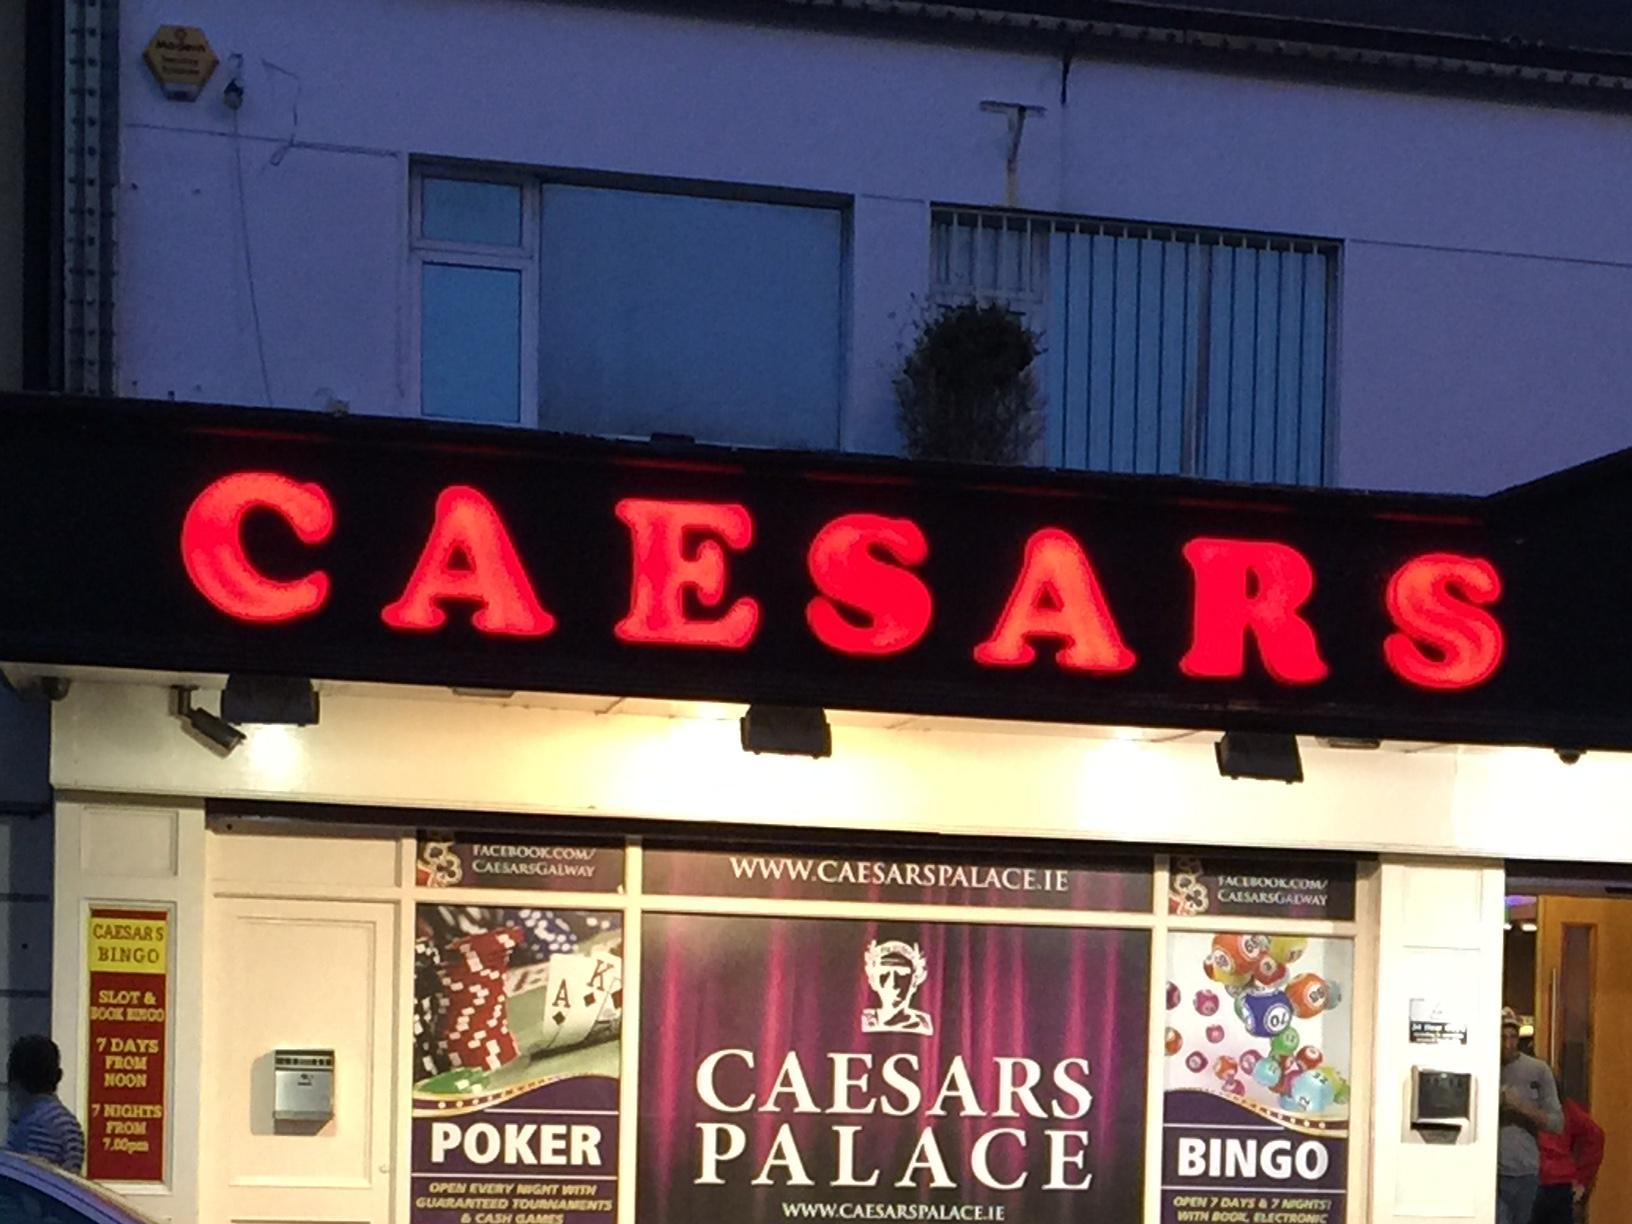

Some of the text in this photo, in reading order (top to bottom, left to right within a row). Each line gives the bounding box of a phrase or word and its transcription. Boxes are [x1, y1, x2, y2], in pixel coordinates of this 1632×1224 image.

[180, 470, 1504, 691] CAESARS
[730, 856, 1069, 892] WWW.CAESARSPALACE.IE
[93, 923, 164, 941] CAESARS
[98, 946, 159, 963] BINGO
[586, 959, 614, 991] K
[99, 990, 156, 1005] SLOT &
[552, 978, 571, 1008] A
[96, 1037, 159, 1053] 7 DAYS
[105, 1055, 147, 1070] FROM
[104, 1073, 147, 1087] NOON
[694, 1048, 1094, 1120] CAESARS
[92, 1104, 162, 1117] 7 NIGHTS
[106, 1121, 147, 1134] FROM
[431, 1121, 602, 1166] POKER
[694, 1122, 1094, 1191] PALACE
[1177, 1137, 1329, 1181] BINGO
[429, 1182, 597, 1196] OPEN EVERY NIGHT WITH
[416, 1197, 612, 1211] GUARANTEED TOURNAMENTS
[1173, 1196, 1207, 1207] OPEN
[1210, 1197, 1217, 1208] 7
[1220, 1196, 1255, 1208] DAYS
[1258, 1197, 1268, 1208] &
[1270, 1198, 1278, 1209] 7
[460, 1213, 471, 1224] &
[475, 1213, 511, 1224] CASH
[782, 1202, 1005, 1221] WWW.CAESARSPALACE.IE
[1177, 1211, 1209, 1222] WITH
[1253, 1213, 1328, 1224] ELECTRONIC
